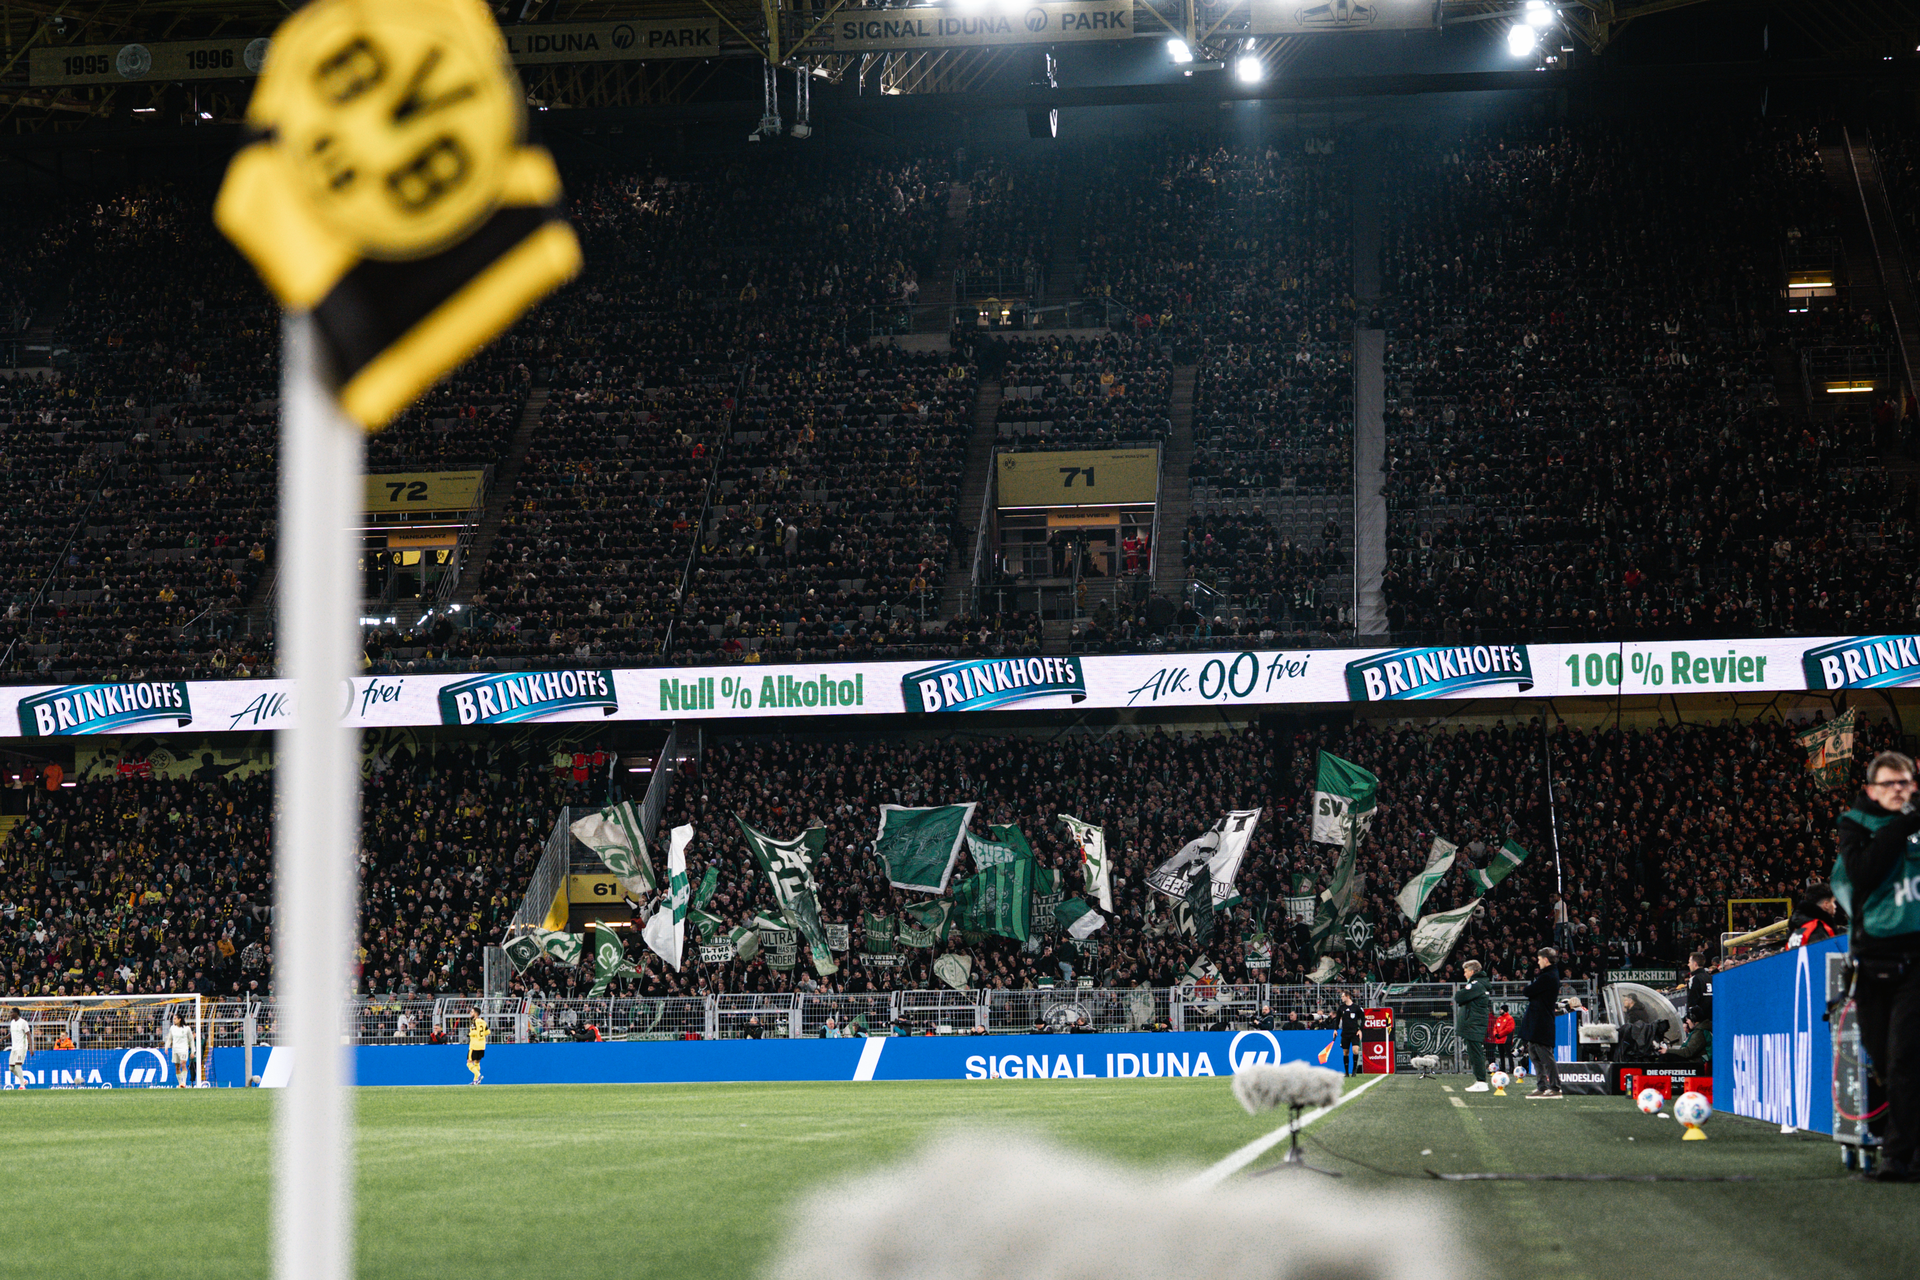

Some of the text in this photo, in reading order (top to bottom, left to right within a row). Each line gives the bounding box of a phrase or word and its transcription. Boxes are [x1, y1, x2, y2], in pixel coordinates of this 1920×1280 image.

[842, 10, 1126, 40] SIGNAL IDUNA PARK
[527, 33, 599, 53] IDUNA
[649, 28, 712, 48] PARK
[63, 54, 109, 76] 1995
[186, 49, 234, 70] 1996
[1059, 467, 1095, 487] 71
[386, 481, 428, 502] 72
[1565, 649, 1767, 688] 100 % Revier
[1818, 635, 1920, 690] BRINK
[1128, 652, 1311, 707] Alk. 0,0 frei
[361, 677, 403, 718] frei
[659, 672, 864, 711] Null % Alkohol
[1318, 797, 1342, 818] SV
[593, 882, 617, 896] 61
[704, 953, 729, 961] BOYS
[1607, 970, 1677, 982] ISELERSHEIM
[1364, 1019, 1387, 1027] CHEC
[965, 1051, 1216, 1080] SIGNAL IDUNA
[1558, 1073, 1605, 1083] UNDESLIGA
